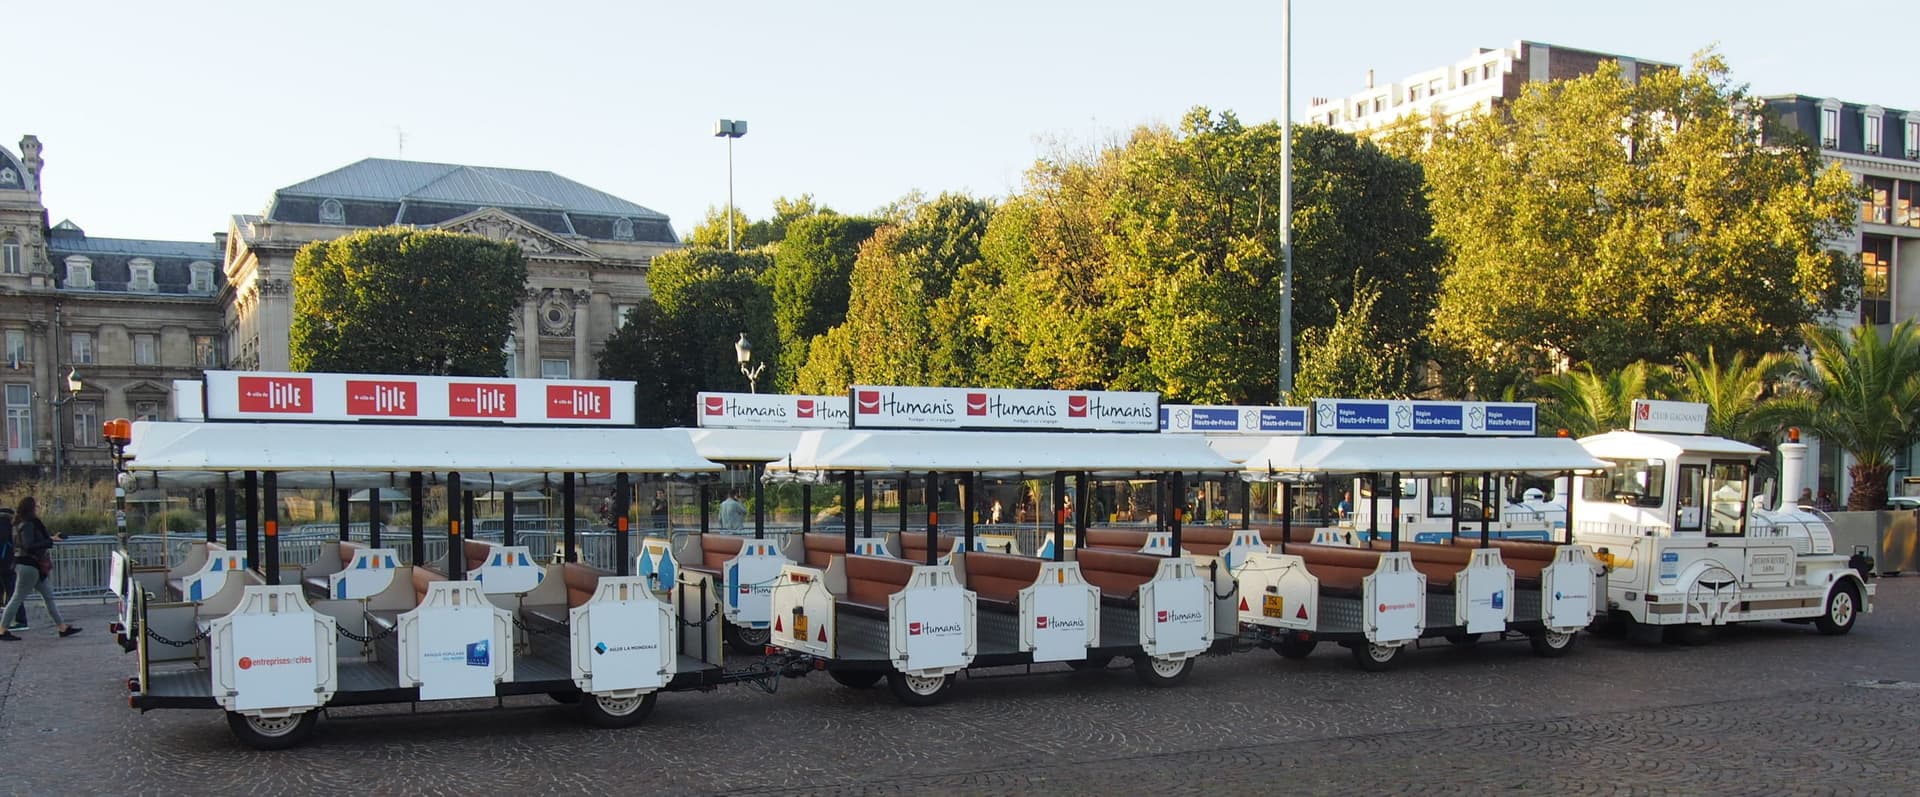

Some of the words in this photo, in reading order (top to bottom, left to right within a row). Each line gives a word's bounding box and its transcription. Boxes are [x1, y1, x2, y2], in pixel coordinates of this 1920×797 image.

[726, 397, 787, 417] Humanis
[883, 392, 954, 416] Humanis
[989, 394, 1057, 418] Humanis
[1090, 396, 1152, 419] Humanis
[1339, 416, 1386, 425] Hauts-de-France
[1416, 417, 1460, 425] Hauts-de-France
[1488, 418, 1531, 426] Hauts-de-France
[1440, 502, 1446, 511] 2
[1048, 615, 1085, 629] Humanis
[1169, 610, 1202, 622] Humanis
[922, 621, 961, 635] Humanis
